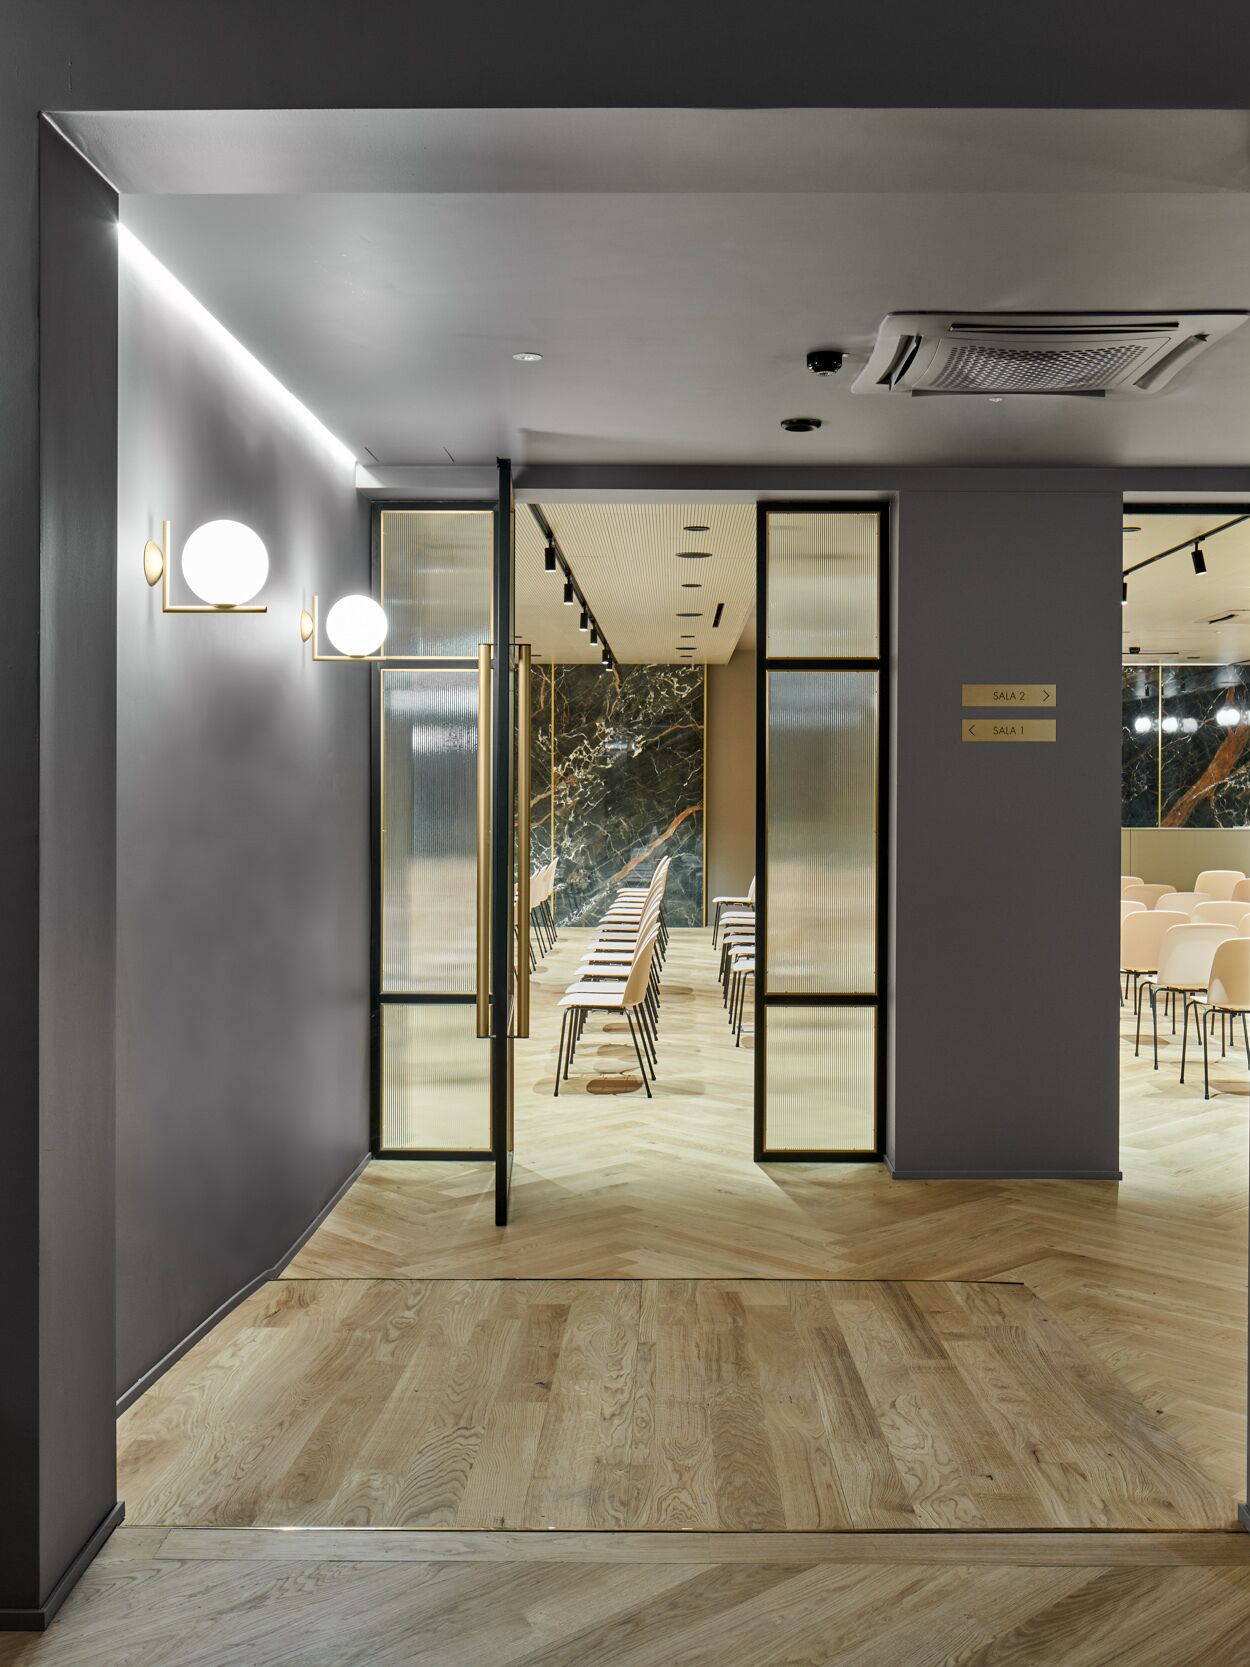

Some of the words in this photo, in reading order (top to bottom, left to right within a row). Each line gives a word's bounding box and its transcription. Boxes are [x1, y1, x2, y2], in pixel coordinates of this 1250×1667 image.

[992, 692, 1016, 700] SALA
[1020, 692, 1026, 700] 2
[992, 726, 1016, 735] SALA
[1020, 726, 1024, 735] 1
